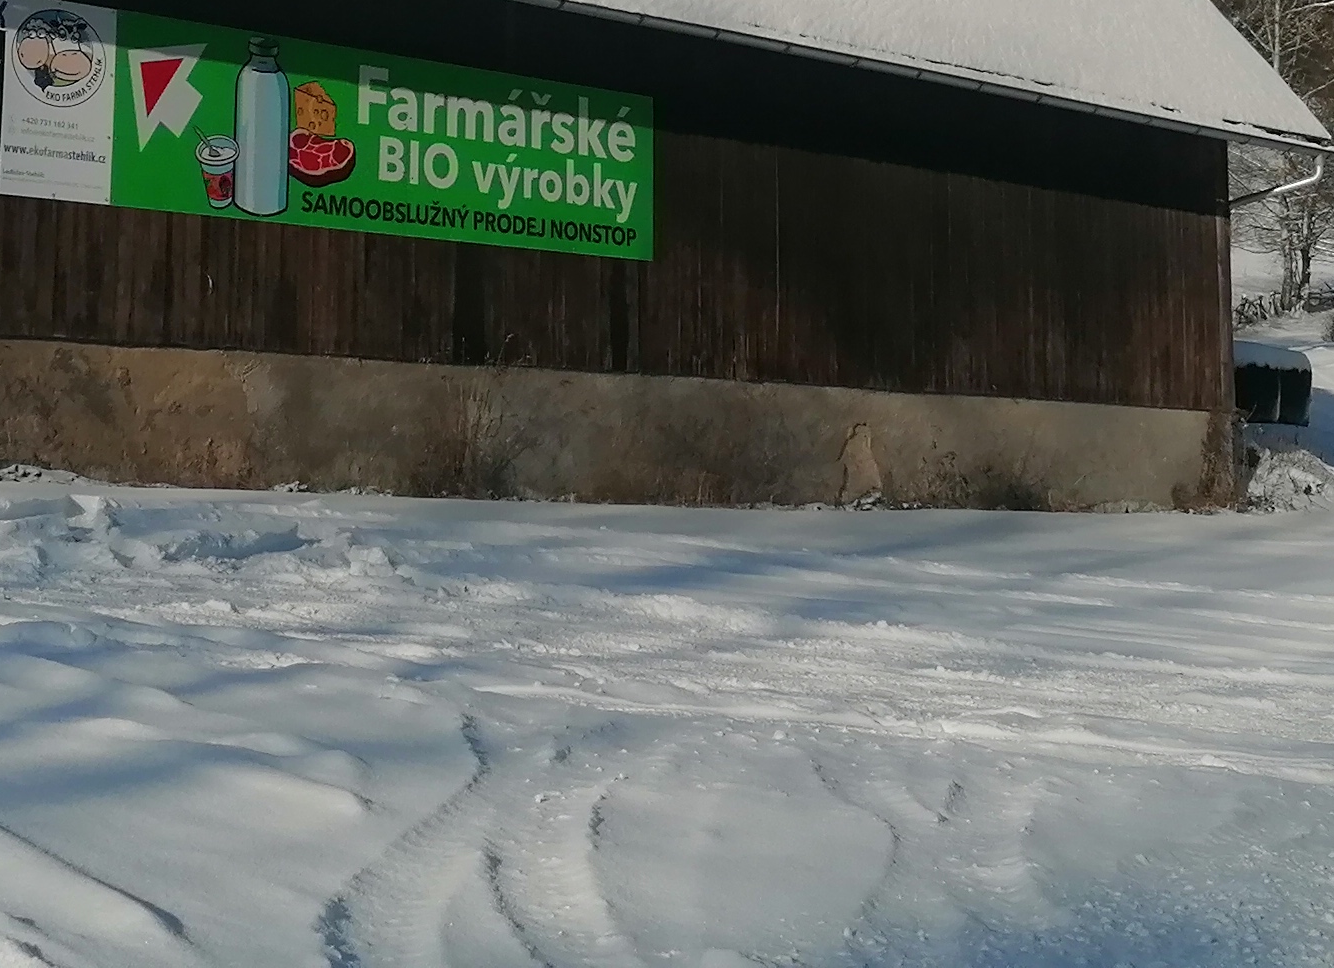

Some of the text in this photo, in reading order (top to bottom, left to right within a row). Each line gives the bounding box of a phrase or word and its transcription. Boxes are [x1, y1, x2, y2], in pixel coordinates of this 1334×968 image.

[46, 91, 60, 101] EKO
[62, 88, 87, 101] FARMA
[357, 64, 637, 162] Farmářské
[378, 135, 638, 223] BIO výrobky
[301, 191, 637, 246] SAMOOBSLUŽNÝ PRODEJ NONSTOP
